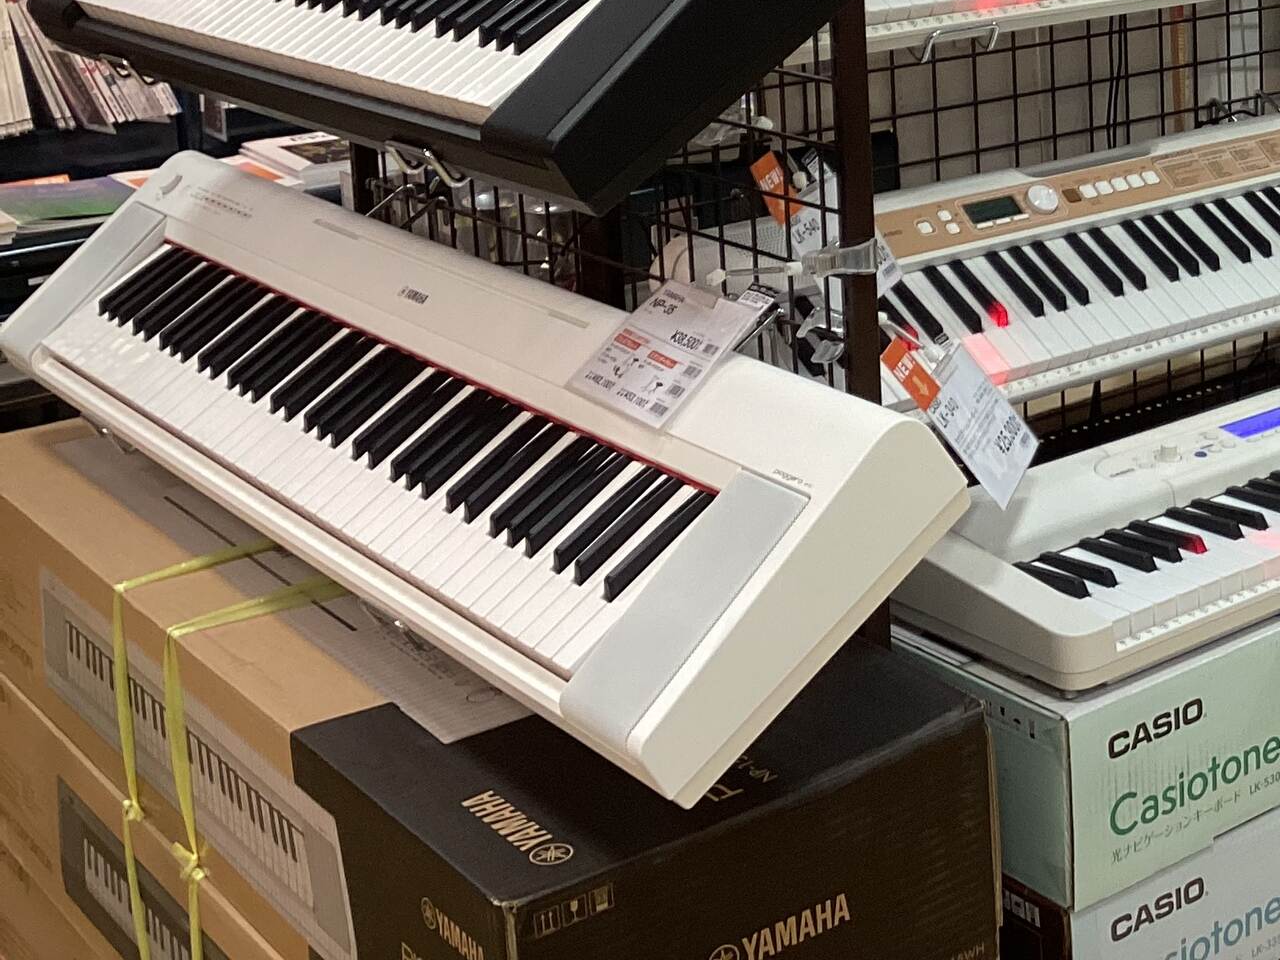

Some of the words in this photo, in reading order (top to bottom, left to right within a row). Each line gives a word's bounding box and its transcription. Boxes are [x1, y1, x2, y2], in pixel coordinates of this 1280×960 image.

[1107, 698, 1204, 759] CASIO
[461, 790, 553, 852] YAMAHA
[1111, 792, 1241, 865] 光ナビゲーションキーボード
[742, 892, 851, 960] YAMAHA
[1110, 876, 1205, 942] CASIO
